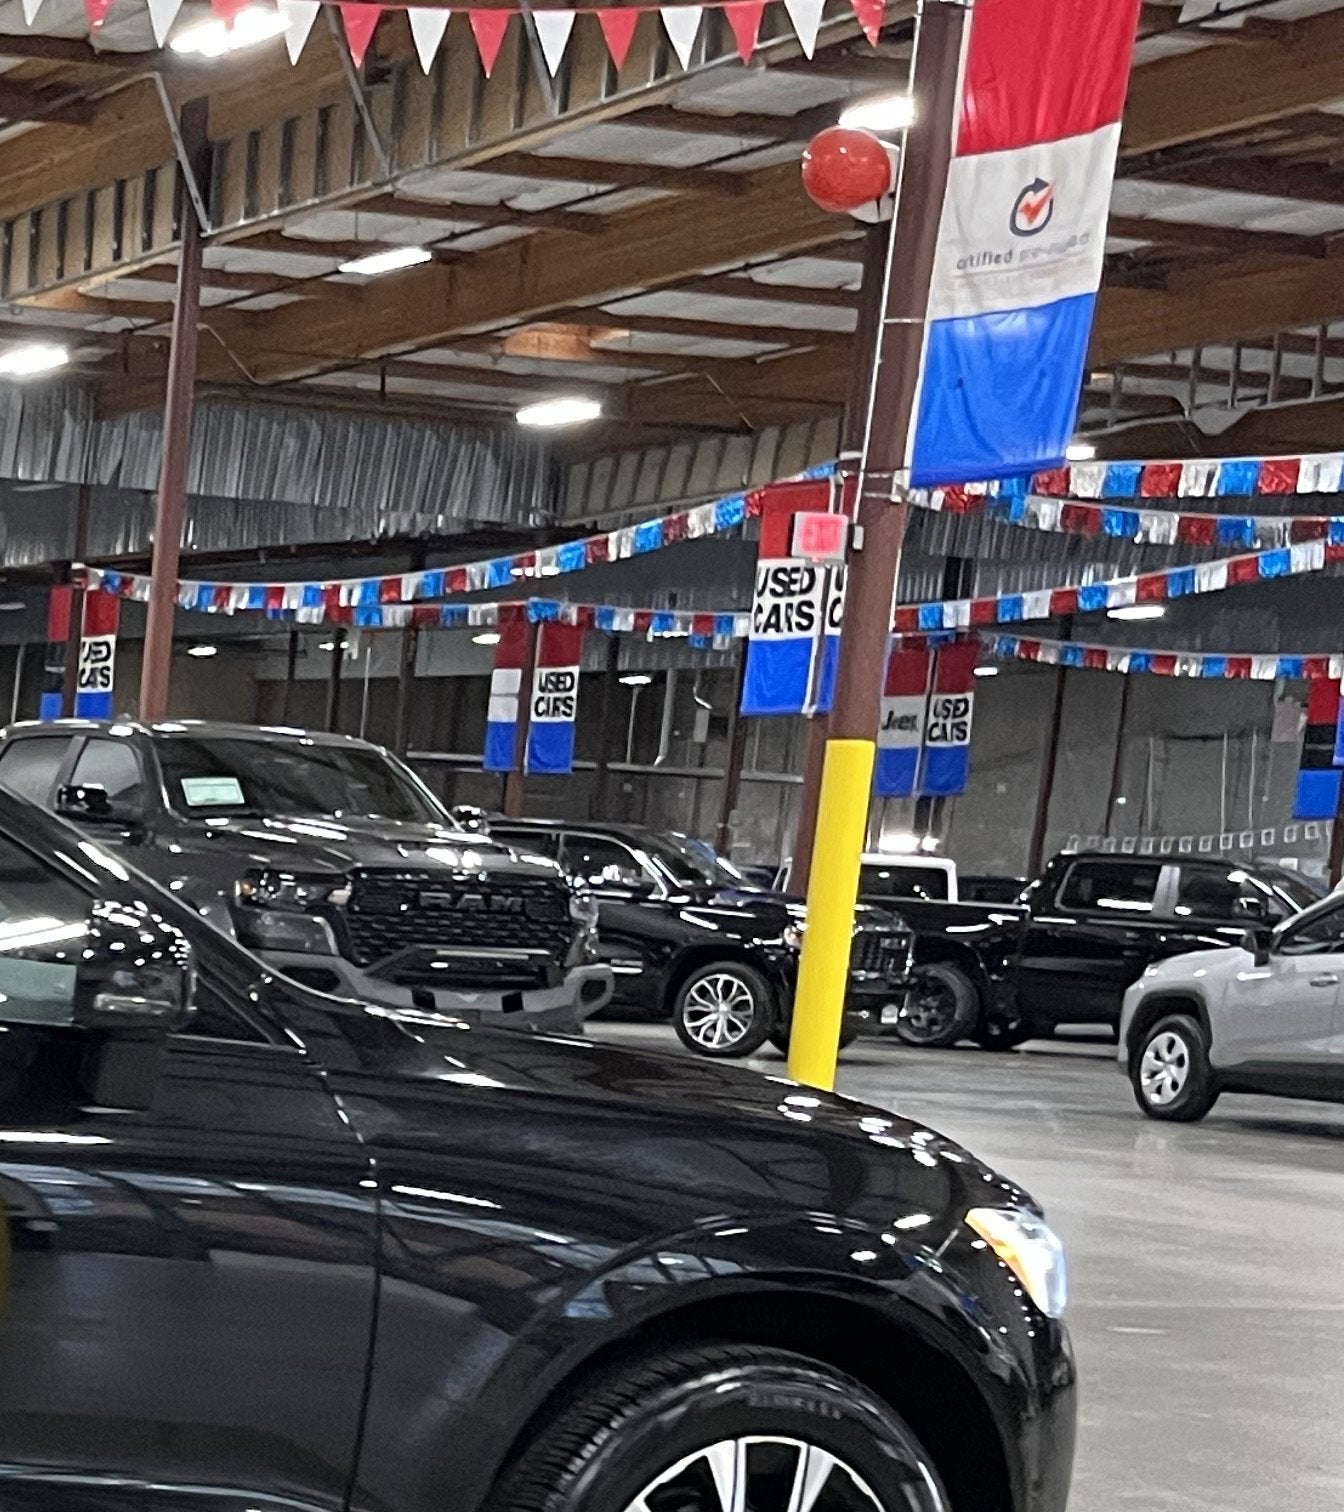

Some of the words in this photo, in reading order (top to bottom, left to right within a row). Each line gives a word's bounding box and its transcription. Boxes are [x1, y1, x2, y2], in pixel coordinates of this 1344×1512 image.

[78, 665, 111, 689] CAS
[538, 671, 576, 694] USED
[419, 891, 523, 912] RAM
